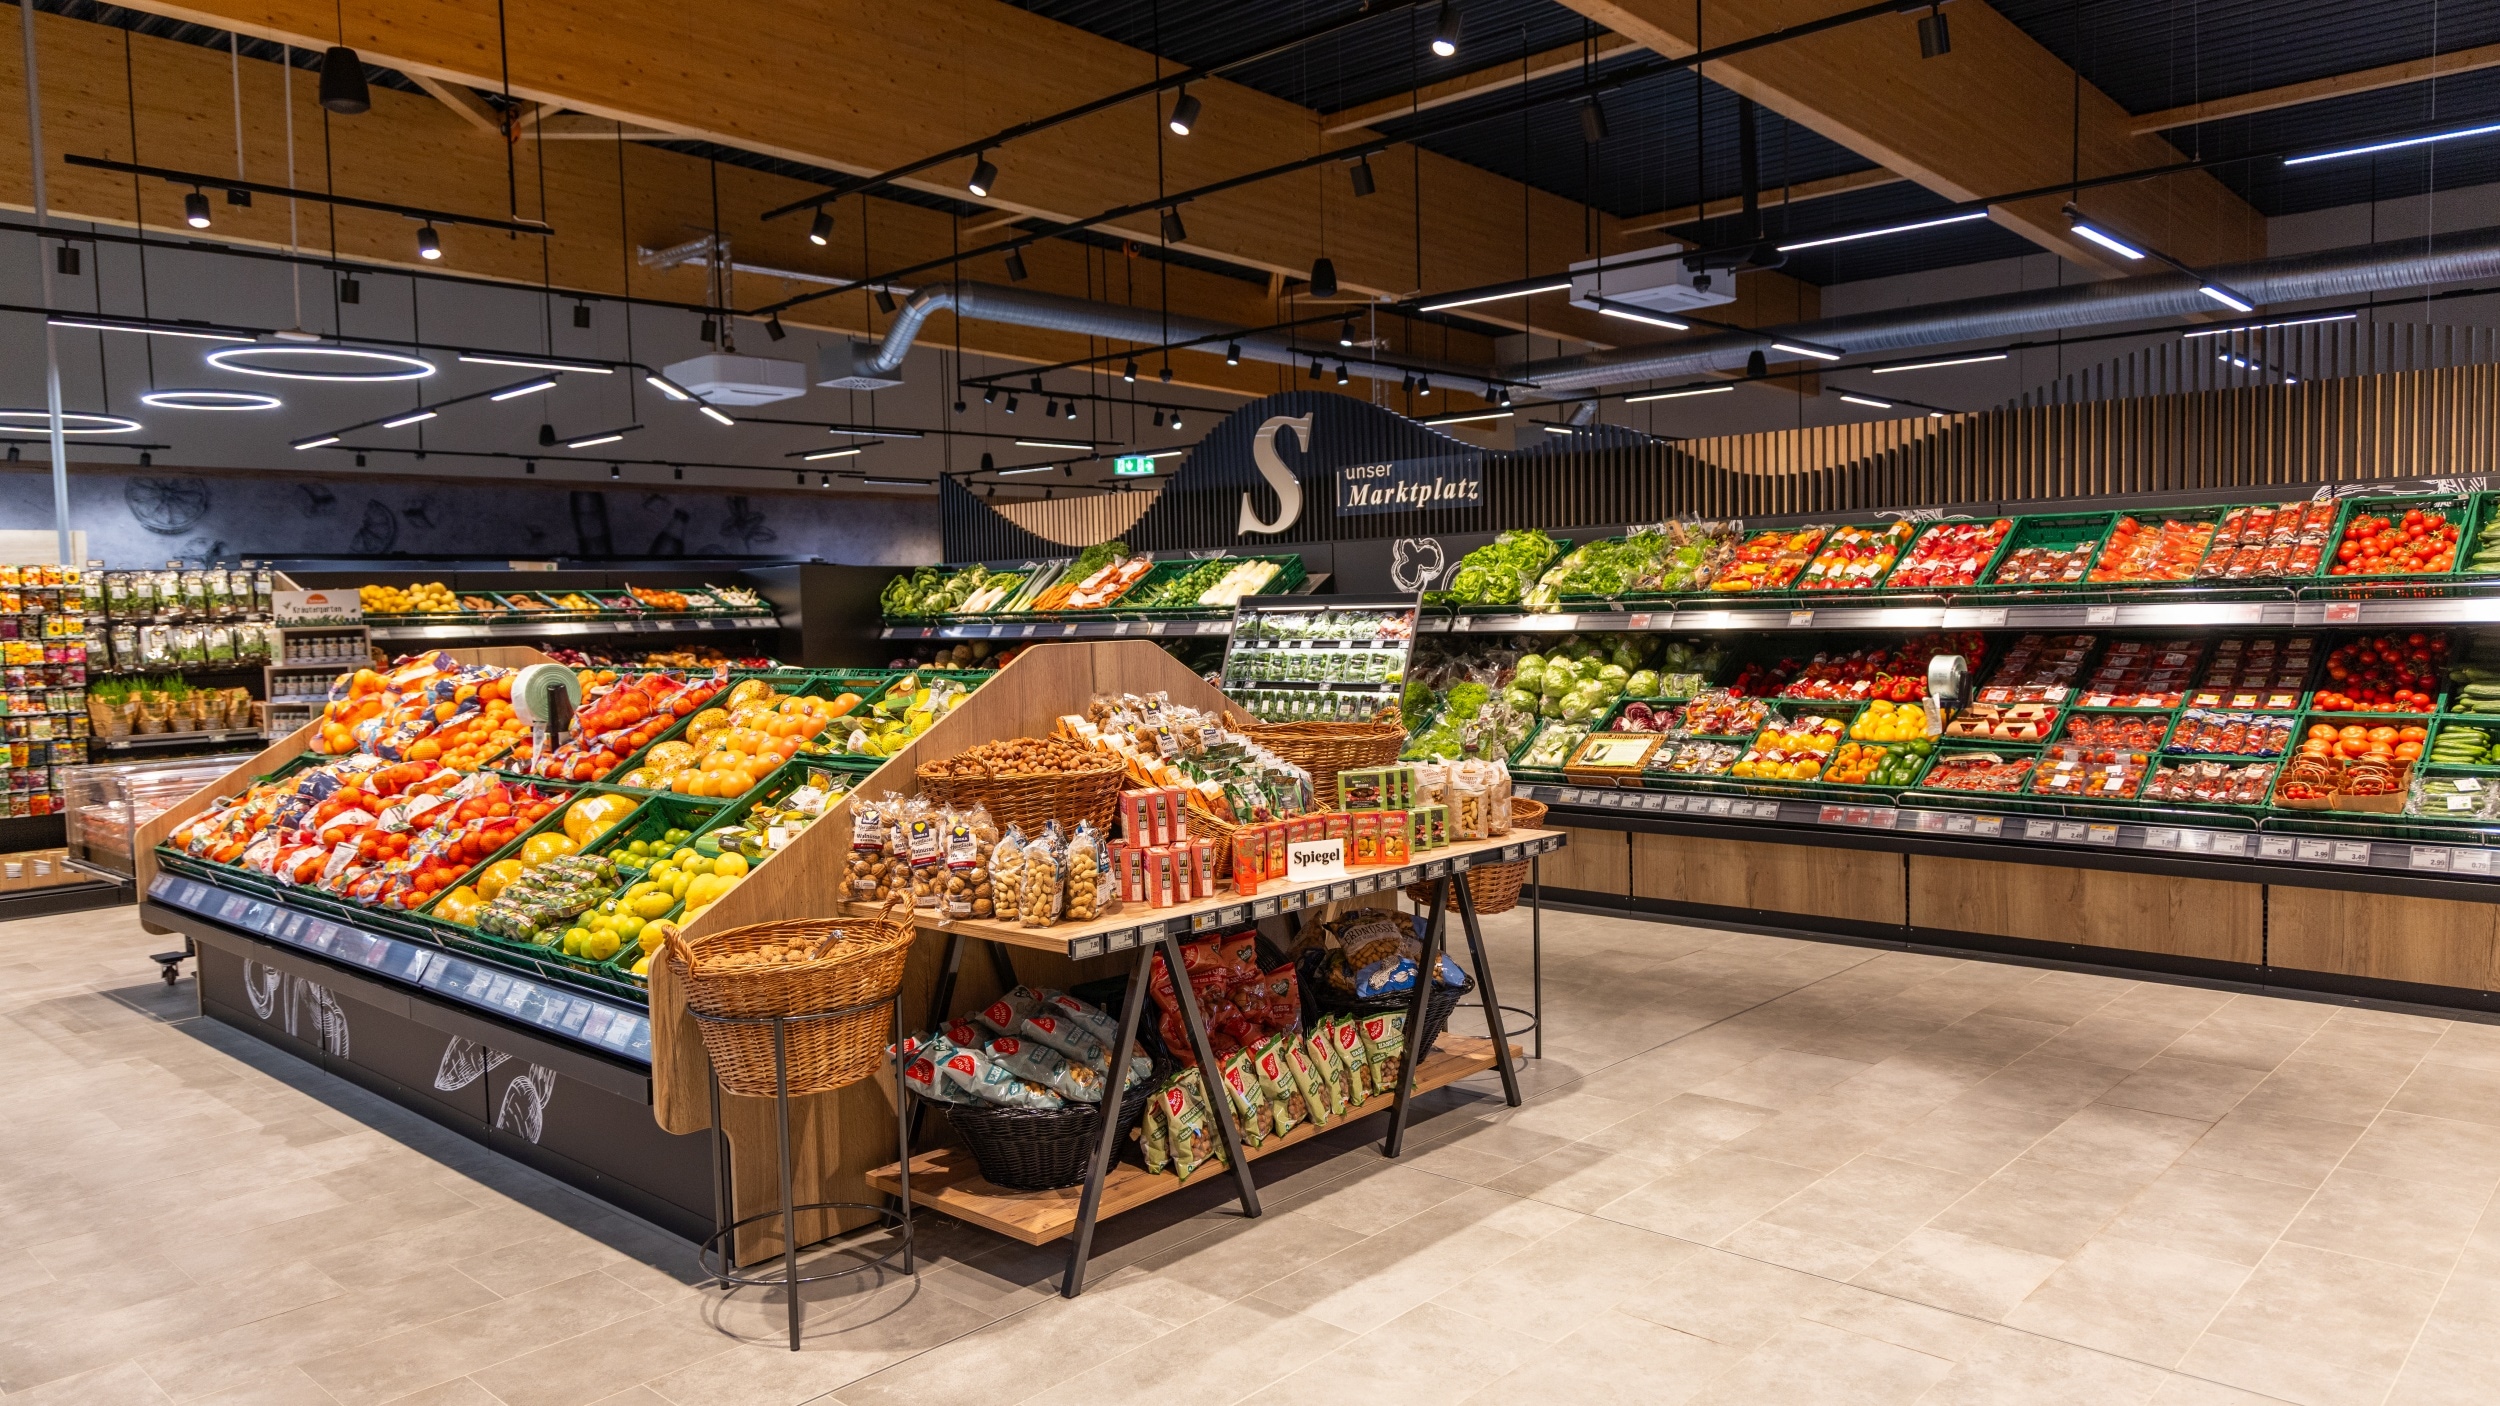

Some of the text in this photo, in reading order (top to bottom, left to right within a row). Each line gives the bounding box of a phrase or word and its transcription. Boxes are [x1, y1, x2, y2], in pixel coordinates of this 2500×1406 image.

[1238, 412, 1313, 536] S
[1346, 464, 1392, 480] unser
[1347, 477, 1479, 508] Marktplatz
[1294, 848, 1340, 867] Spiegel
